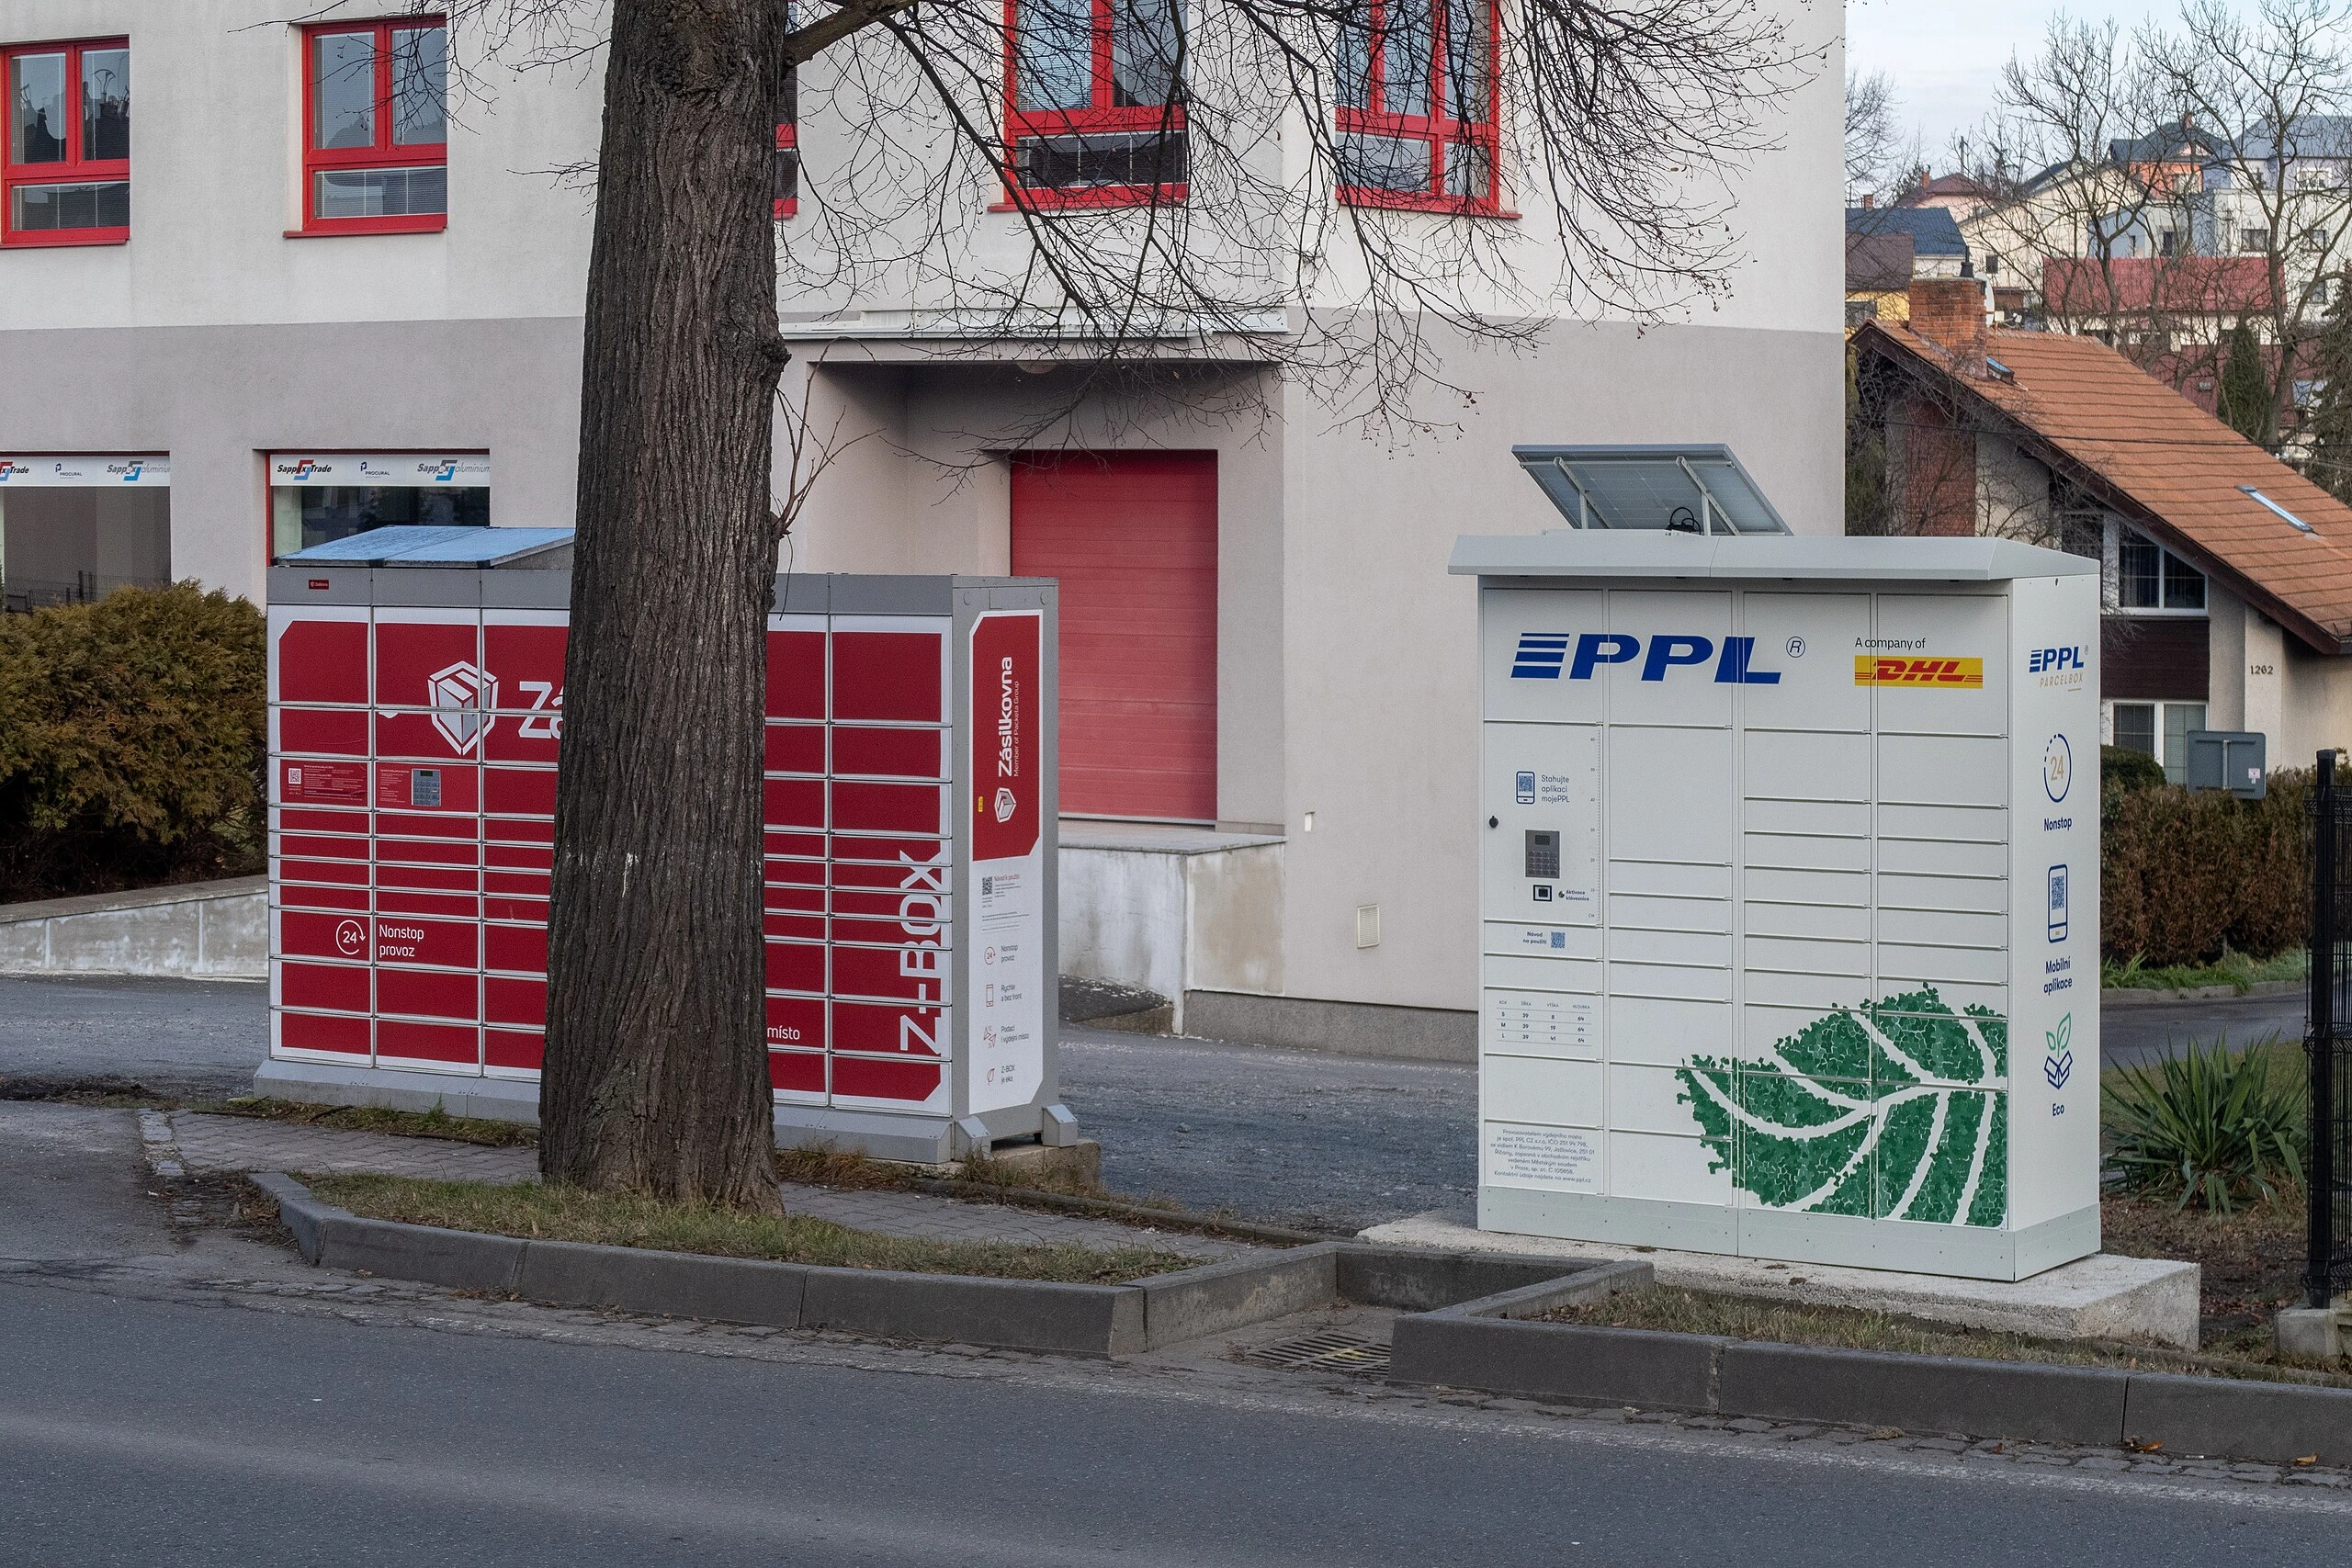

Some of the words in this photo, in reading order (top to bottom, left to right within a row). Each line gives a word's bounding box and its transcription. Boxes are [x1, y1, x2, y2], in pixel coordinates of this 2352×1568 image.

[10, 466, 29, 474] Trade
[311, 465, 332, 473] Trade
[1854, 637, 1862, 648] A
[1865, 638, 1913, 650] company
[1915, 637, 1926, 649] of
[1871, 660, 1961, 682] DHL
[2040, 671, 2084, 688] PARCELBOX
[998, 656, 1012, 778] Zásilkovna
[1013, 737, 1019, 745] of
[2050, 755, 2064, 781] 24
[1541, 774, 1570, 784] Stahujte
[1541, 785, 1568, 794] aplikaci
[1541, 795, 1570, 804] mojePPL
[2043, 817, 2073, 831] Nonstop
[343, 931, 356, 943] 24
[379, 924, 424, 942] Nonstop
[379, 945, 415, 959] provoz
[899, 850, 942, 1055] Z-BOX
[2045, 956, 2071, 974] Mobilní
[1001, 984, 1015, 993] Rychle
[2043, 977, 2073, 996] aplikace
[766, 1025, 800, 1040] místo
[1001, 1065, 1015, 1073] Z-BOX
[2052, 1103, 2065, 1116] Eco
